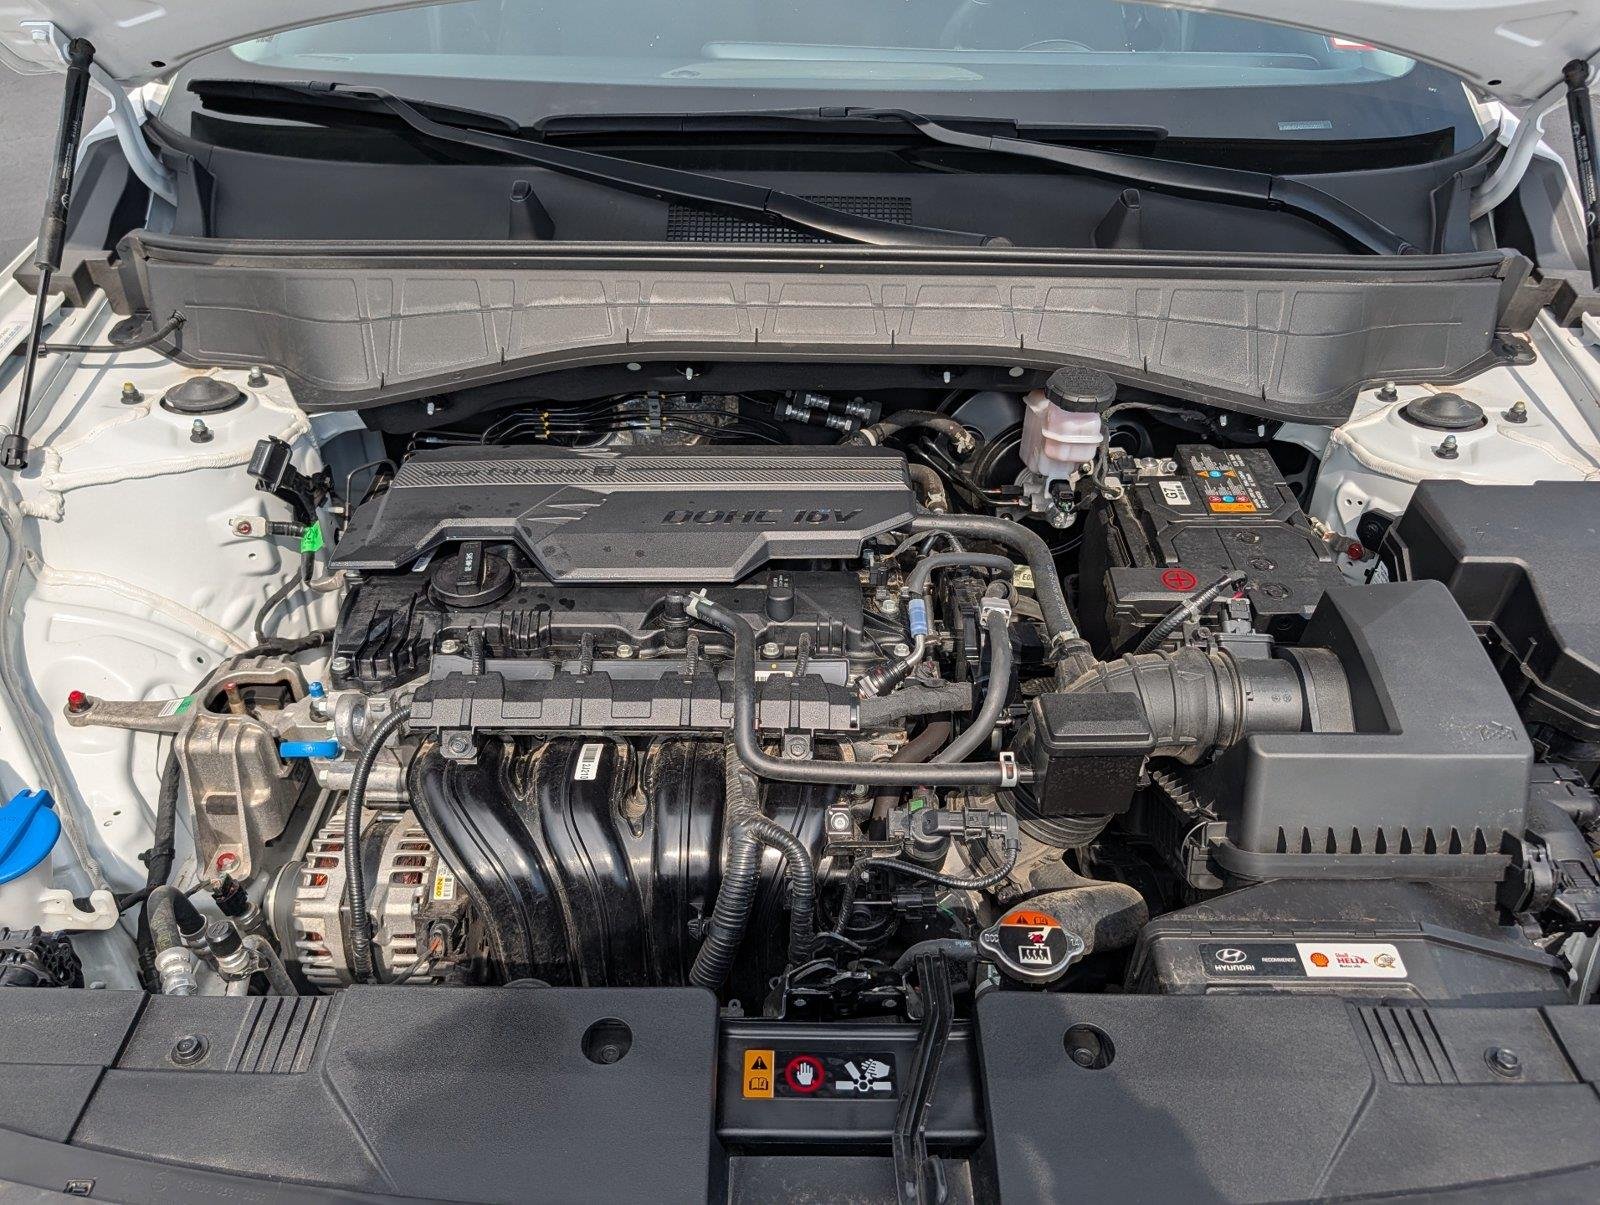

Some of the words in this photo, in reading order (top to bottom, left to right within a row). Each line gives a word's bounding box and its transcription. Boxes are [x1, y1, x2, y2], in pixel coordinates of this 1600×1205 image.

[660, 508, 784, 526] DOHC
[793, 508, 864, 525] 16V
[1336, 957, 1368, 965] HELIX
[1214, 964, 1255, 972] HYUNDAI
